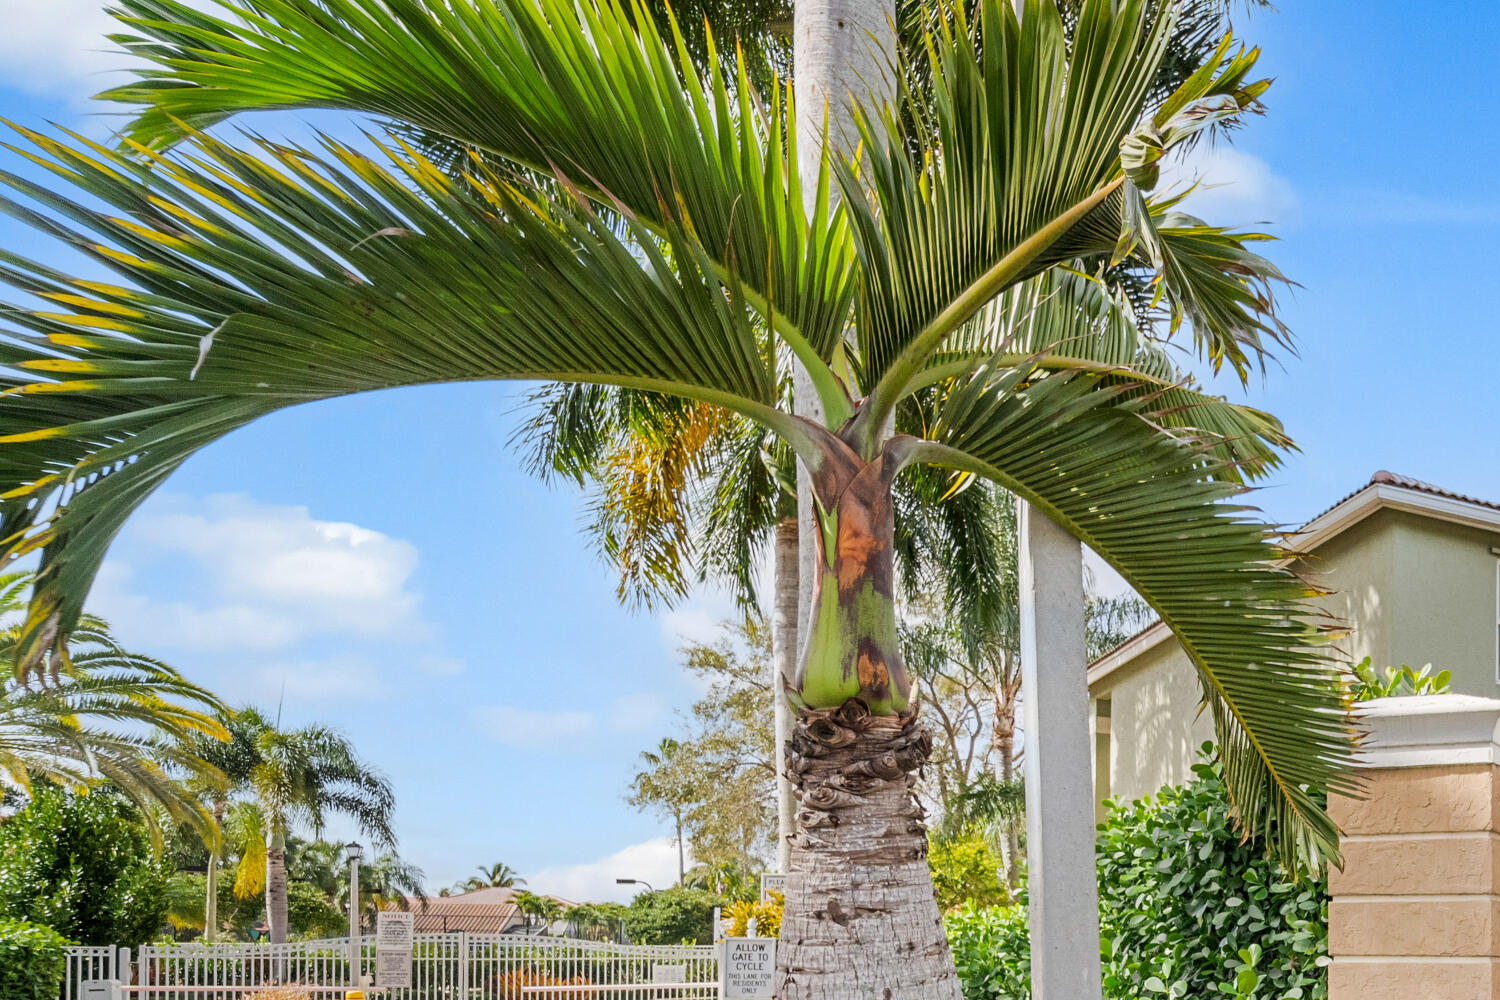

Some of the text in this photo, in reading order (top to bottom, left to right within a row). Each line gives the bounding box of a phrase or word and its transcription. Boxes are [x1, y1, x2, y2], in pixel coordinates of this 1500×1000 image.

[735, 943, 766, 952] ALLOW
[732, 952, 769, 961] GATE TO
[736, 962, 764, 971] CYCLE
[728, 972, 772, 980] THIS LANE FOR
